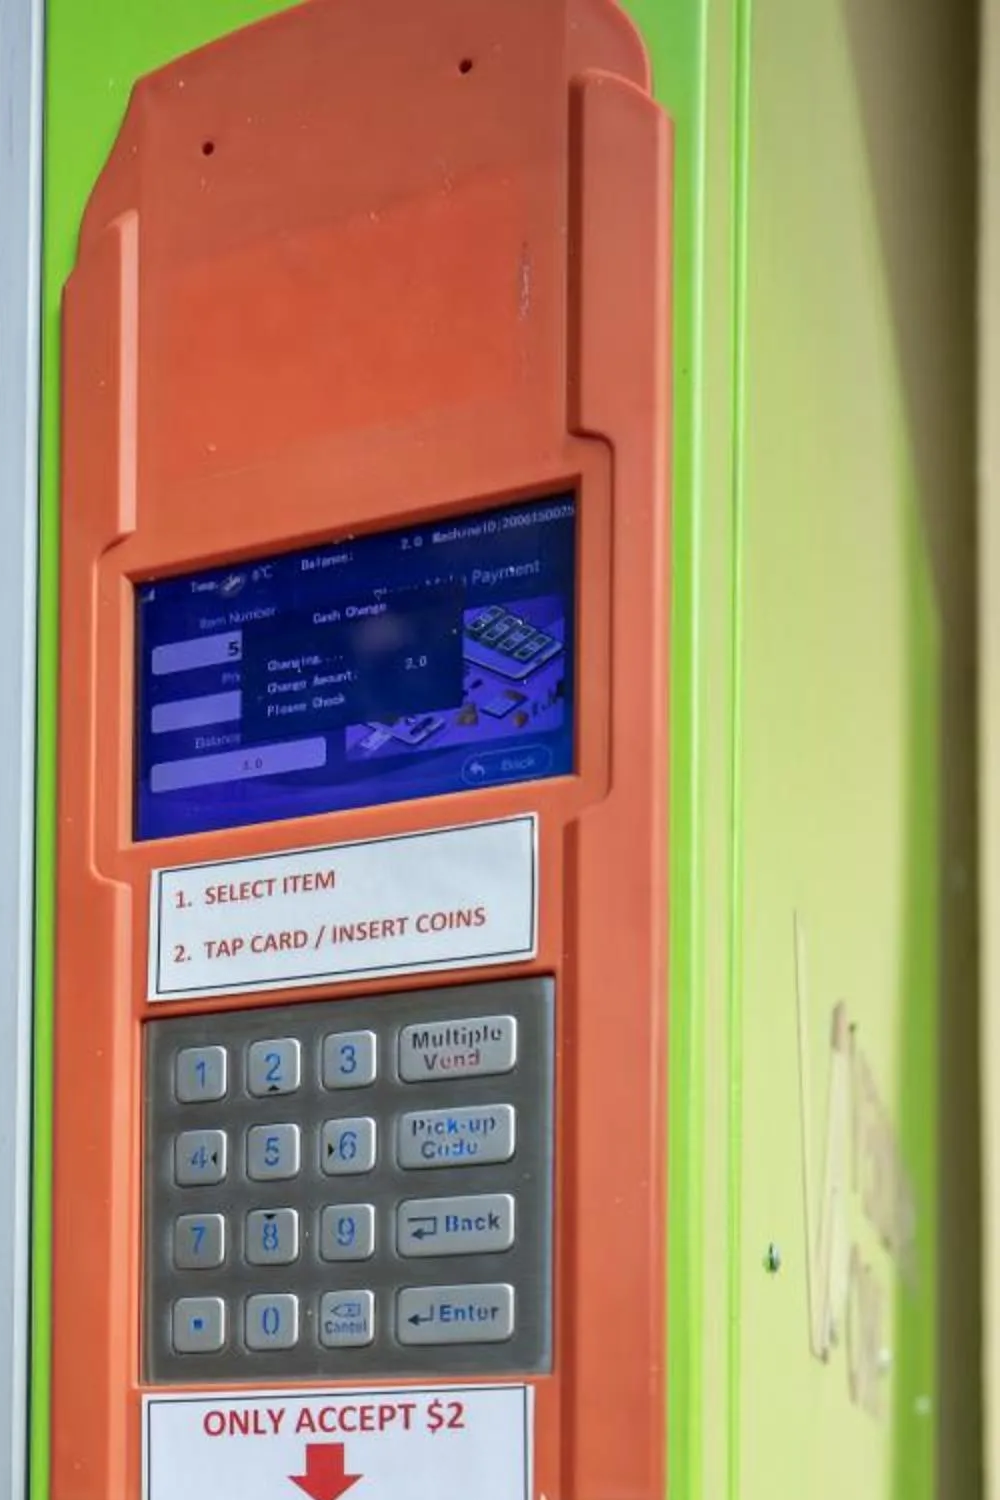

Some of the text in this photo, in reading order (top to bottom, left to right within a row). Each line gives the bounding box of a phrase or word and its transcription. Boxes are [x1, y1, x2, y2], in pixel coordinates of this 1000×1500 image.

[471, 559, 540, 586] Payment
[229, 606, 277, 624] Number
[175, 869, 336, 909] 1. SELECT ITEM
[173, 944, 192, 963] 2.
[204, 937, 244, 960] TAP
[250, 929, 308, 954] CARD
[332, 916, 409, 945] INSERT
[415, 906, 487, 935] COINS
[411, 1024, 503, 1052] Multiple
[264, 1053, 282, 1082] 2
[338, 1045, 357, 1074] 3
[423, 1049, 482, 1071] Vend
[194, 1060, 208, 1089] 1
[411, 1114, 496, 1138] Pick-up
[190, 1144, 207, 1170] 4
[263, 1137, 280, 1166] 5
[338, 1130, 357, 1160] 6
[421, 1137, 477, 1158] Code
[337, 1217, 356, 1247] 9
[444, 1211, 501, 1233] Back
[190, 1226, 207, 1254] 7
[262, 1222, 279, 1252] 8
[261, 1305, 281, 1335] 0
[324, 1318, 368, 1335] Cancel
[438, 1303, 500, 1325] Enter
[203, 1399, 466, 1437] ONLY ACCEPT $2
